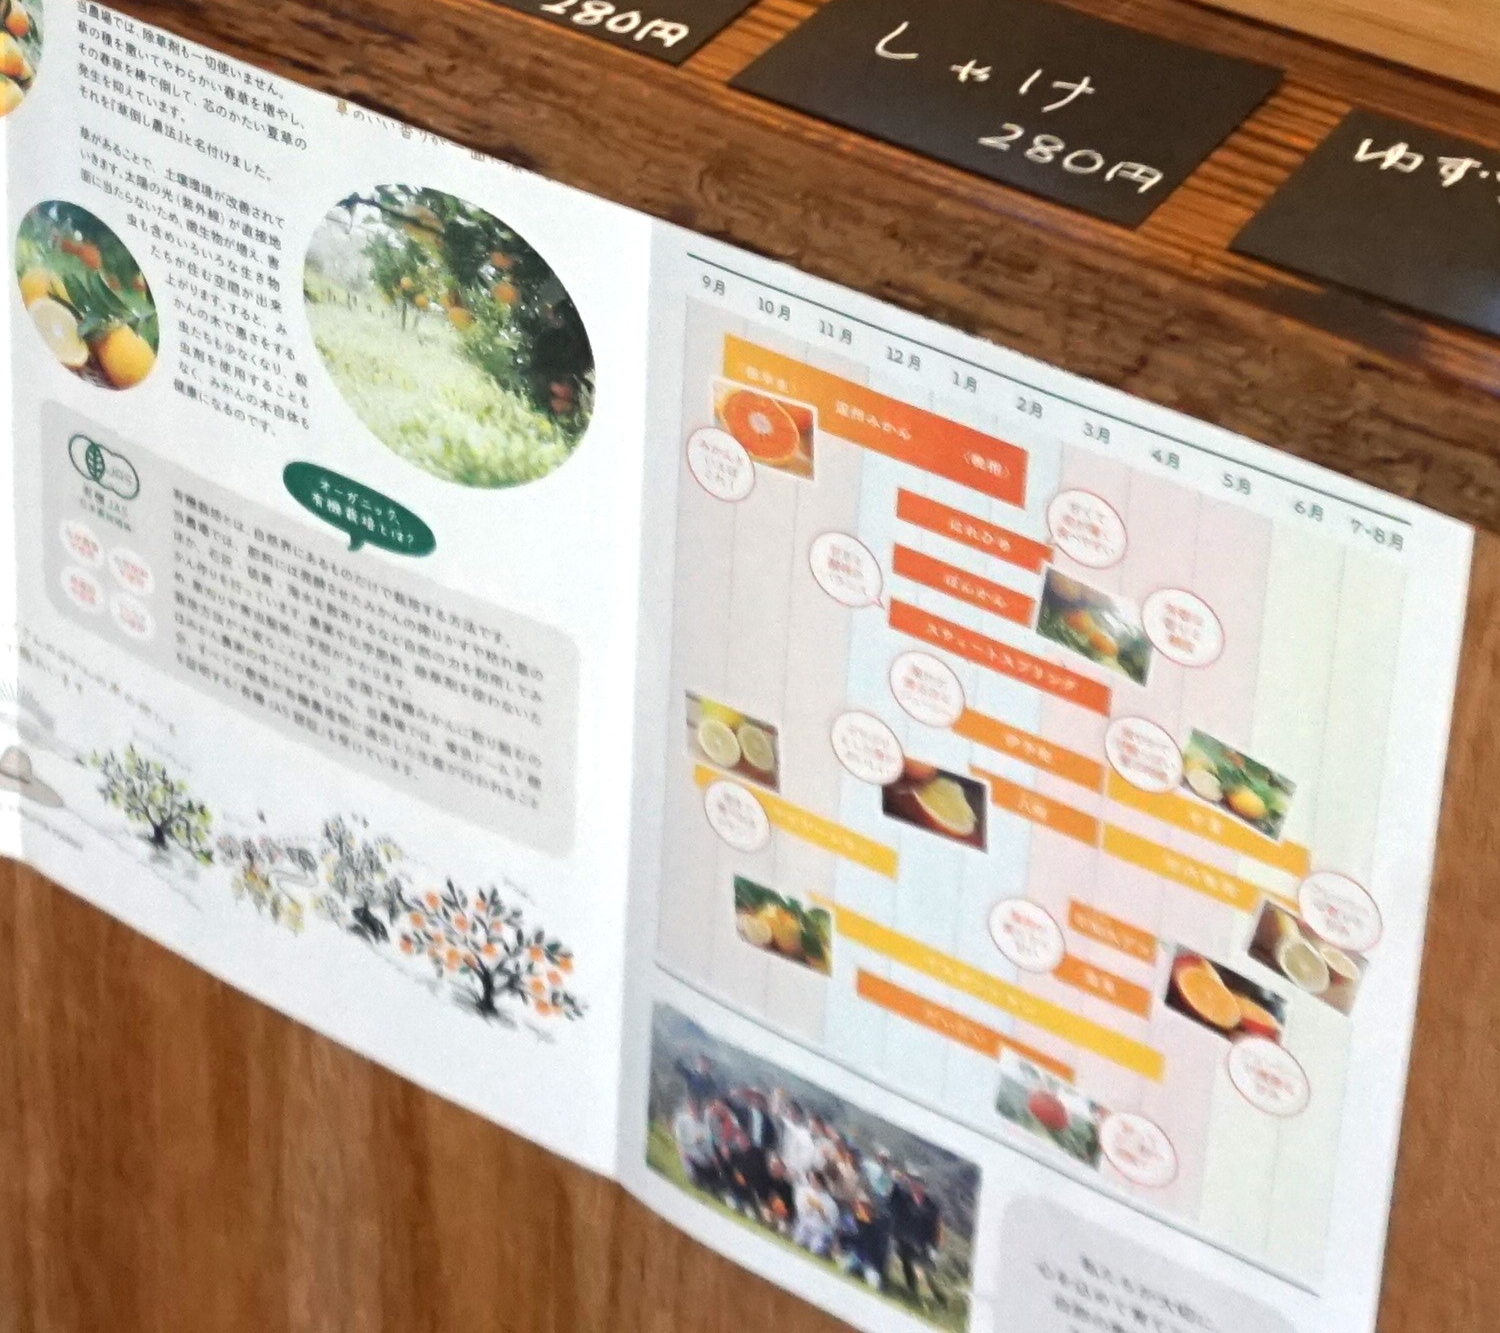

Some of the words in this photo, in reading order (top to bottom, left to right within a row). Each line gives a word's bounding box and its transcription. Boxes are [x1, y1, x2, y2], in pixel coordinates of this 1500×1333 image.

[873, 19, 1096, 111] しゃけ
[977, 121, 1165, 195] 280円
[702, 275, 726, 297] 9月
[758, 296, 792, 322] 10月
[819, 319, 853, 346] 11月
[887, 345, 922, 373] 12月
[952, 370, 978, 394] 1月
[1016, 396, 1043, 419] 2月
[1083, 421, 1111, 446] 3月
[1151, 447, 1181, 470] 4月
[1222, 472, 1252, 496] 5月
[1294, 499, 1325, 523] 6月
